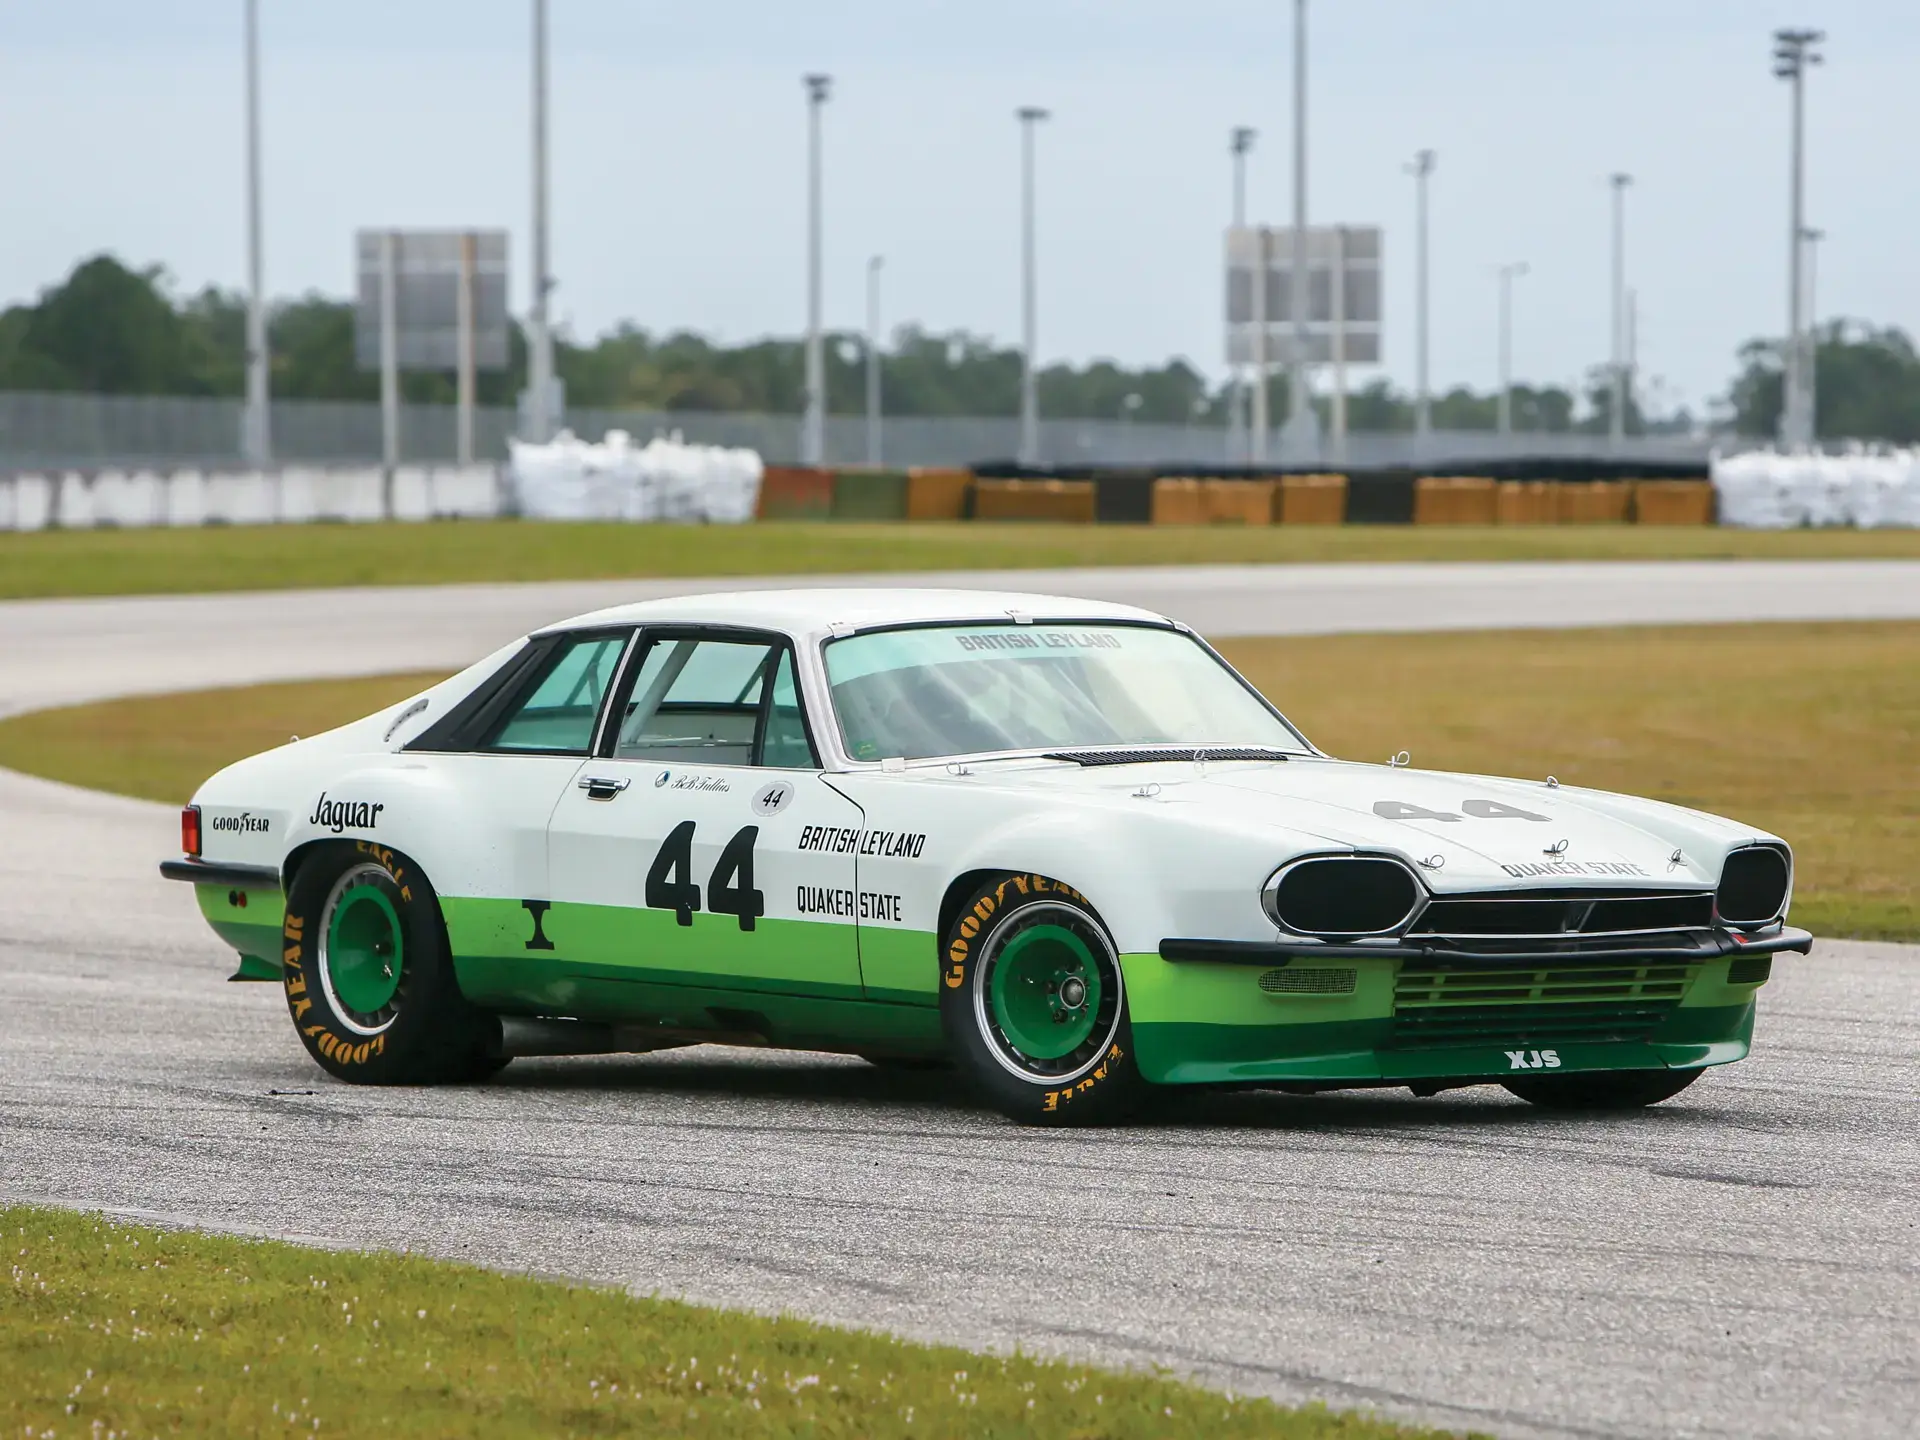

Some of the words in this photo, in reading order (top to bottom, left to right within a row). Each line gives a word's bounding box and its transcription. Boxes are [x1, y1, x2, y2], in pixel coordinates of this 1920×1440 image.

[955, 633, 1039, 651] BRITISH
[1037, 633, 1122, 649] LEYLAND
[310, 792, 384, 833] Jaguar
[762, 789, 784, 808] 44
[1373, 799, 1552, 823] 44
[797, 825, 860, 854] BRITISH
[860, 830, 926, 858] LEYLAND
[645, 820, 764, 932] 44
[1500, 862, 1586, 878] QUAKER
[1587, 861, 1652, 877] STATE
[797, 886, 855, 916] QUAKER
[860, 892, 902, 922] STATE
[284, 913, 384, 1064] GOODYEAR
[1503, 1049, 1563, 1069] XJS
